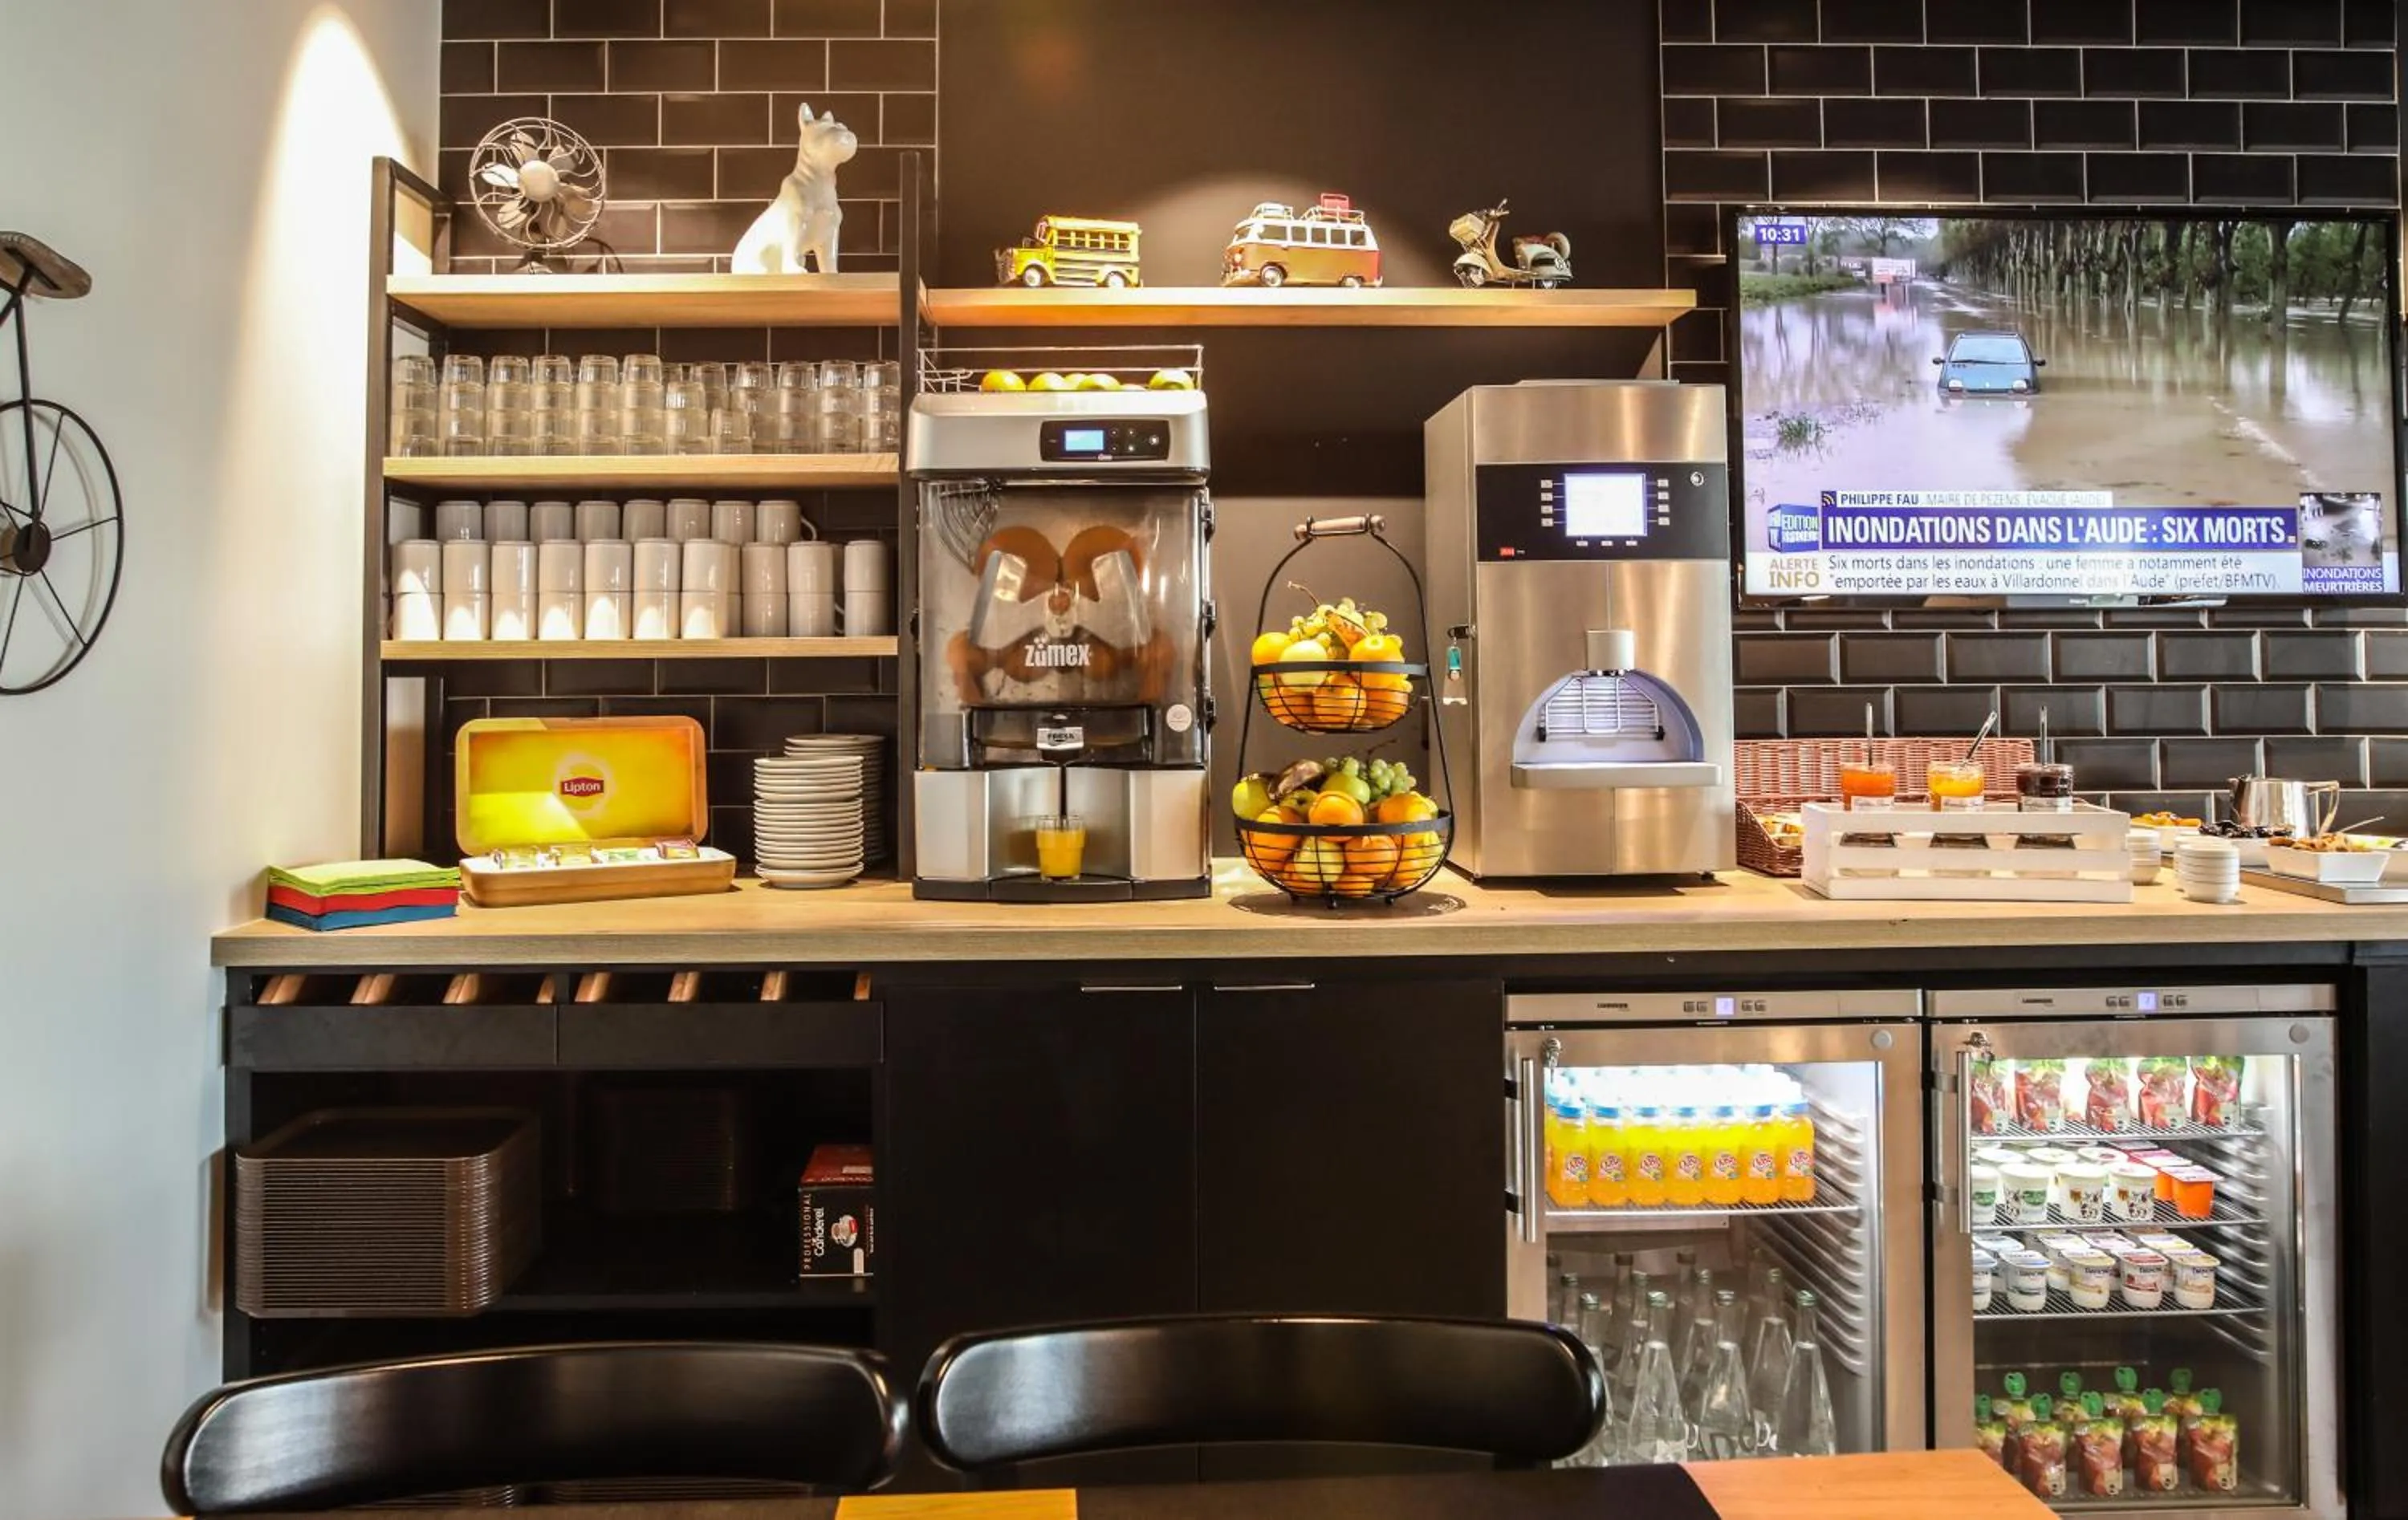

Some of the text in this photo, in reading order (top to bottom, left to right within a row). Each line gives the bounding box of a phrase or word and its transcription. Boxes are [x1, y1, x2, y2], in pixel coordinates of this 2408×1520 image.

[1759, 228, 1800, 241] 10:31
[1841, 494, 1893, 505] PHILIPPE
[1828, 516, 1991, 543] INONDATIONS
[1995, 516, 2061, 543] DANS
[2162, 516, 2199, 543] SIX
[1770, 558, 1817, 570] ALERTE
[1829, 555, 1847, 569] Six
[1852, 556, 1892, 569] morts
[1896, 555, 1928, 569] dans
[1933, 555, 1950, 569] les
[1954, 555, 2035, 569] inondations
[2046, 559, 2071, 569] une
[2076, 555, 2122, 569] femme
[2128, 559, 2134, 569] a
[2139, 555, 2217, 569] notamment
[2221, 555, 2242, 569] été
[1769, 571, 1820, 587] INFO
[2303, 568, 2382, 579] INONDATIONS
[1906, 577, 1927, 590] par
[1933, 574, 1950, 587] les
[1954, 577, 1987, 587] eaux
[1991, 574, 1999, 587] à
[2002, 573, 2084, 587] Villardonnel
[2088, 573, 2119, 587] dans
[2304, 579, 2383, 591] MEURTRIÈRES
[564, 782, 600, 795] Lipton
[803, 1193, 812, 1270] PROFESSIONAL
[812, 1206, 825, 1258] Canderel
